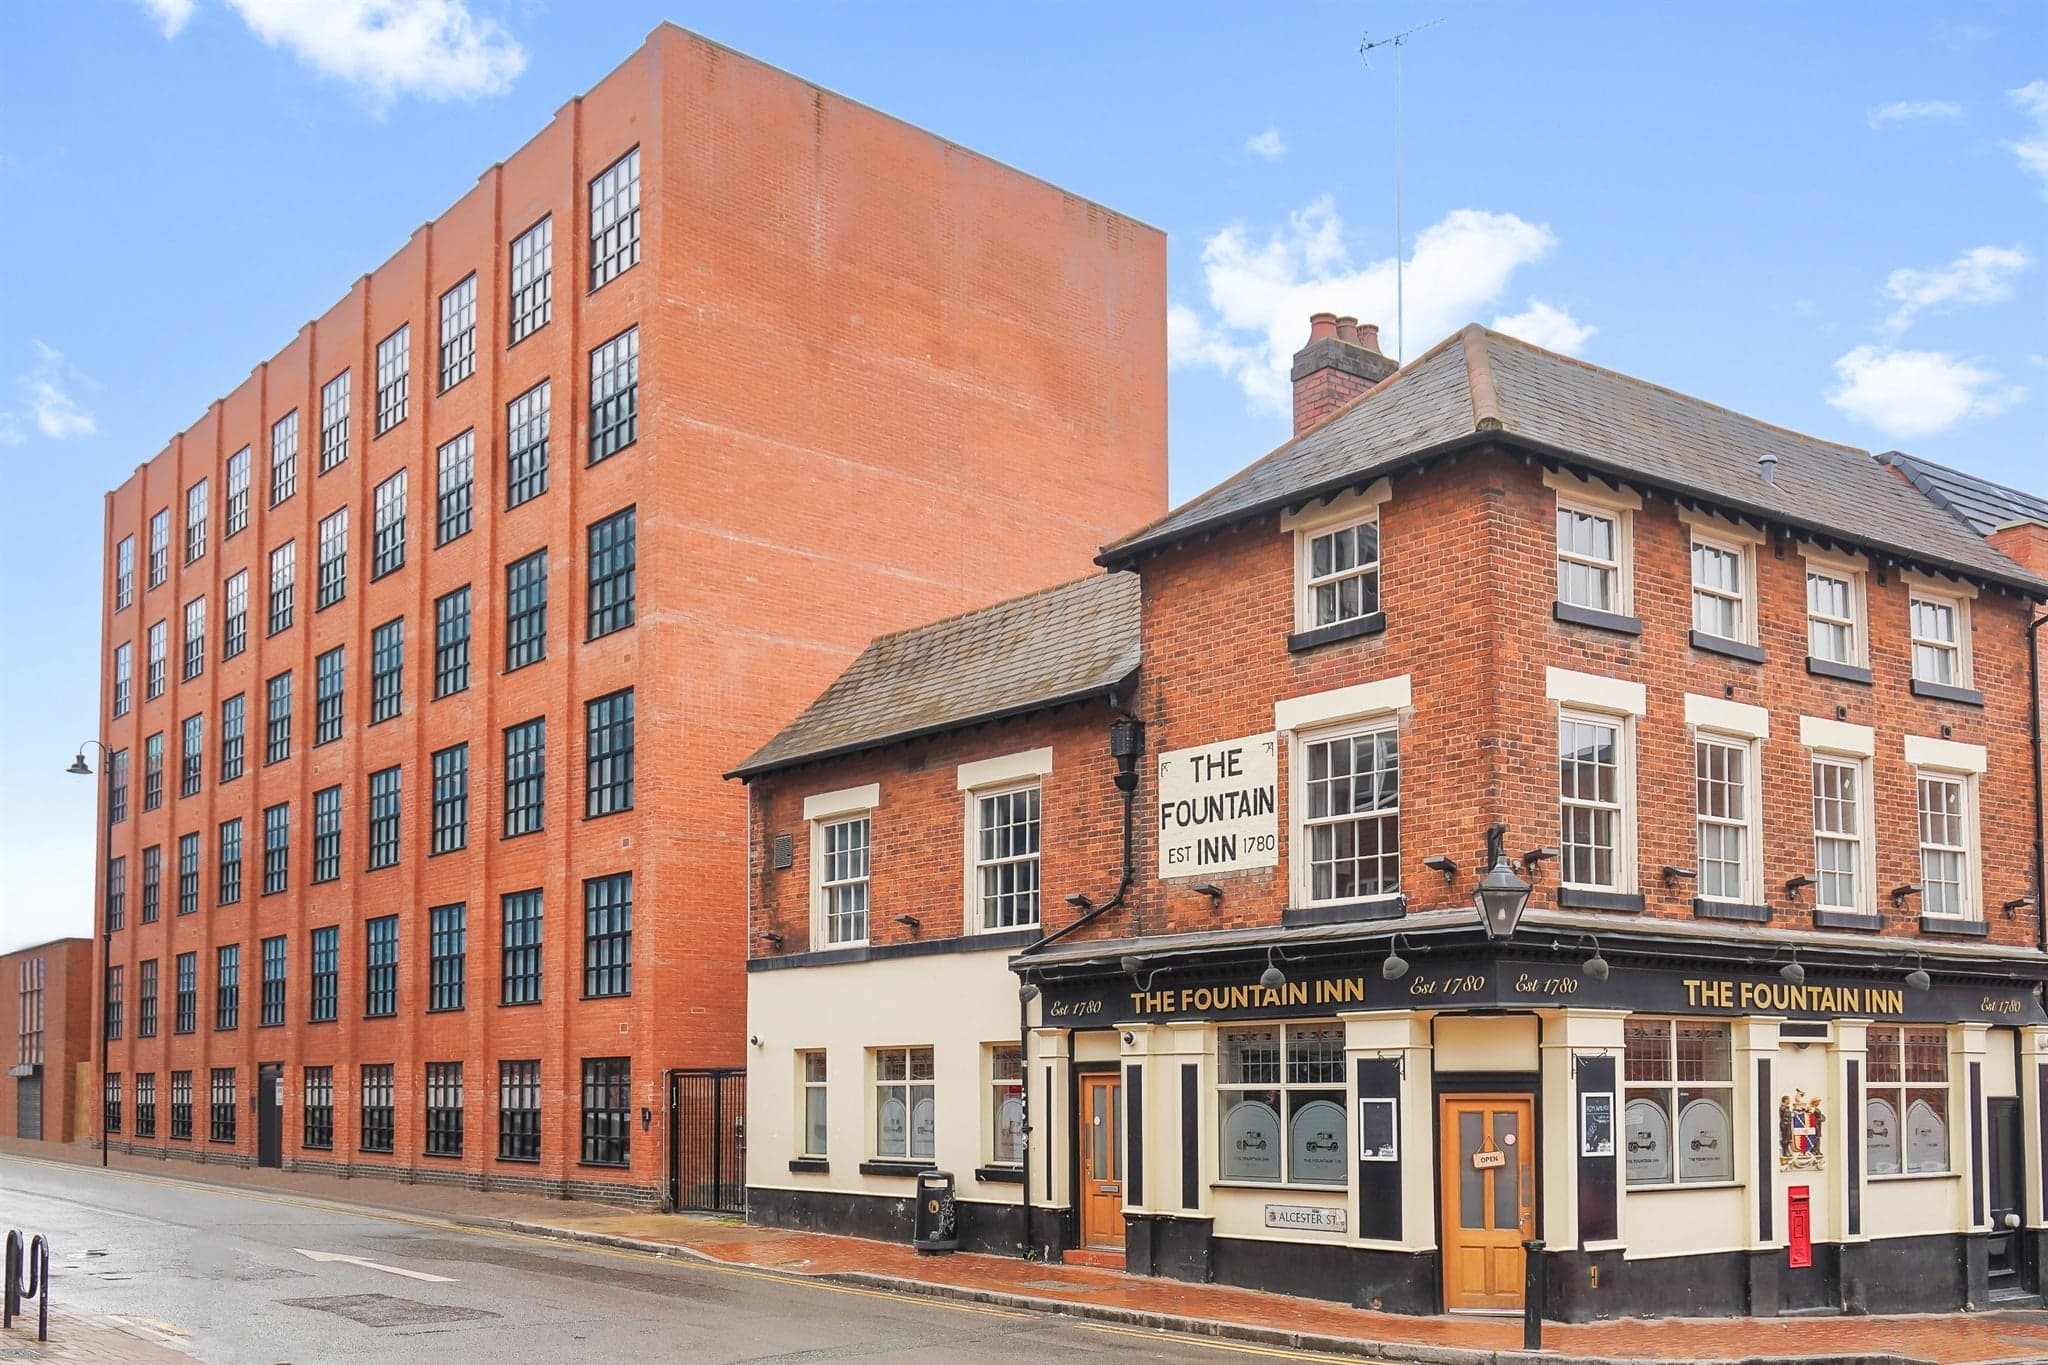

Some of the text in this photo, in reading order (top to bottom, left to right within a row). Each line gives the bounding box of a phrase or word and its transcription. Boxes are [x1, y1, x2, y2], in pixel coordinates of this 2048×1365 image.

[1190, 748, 1243, 783] THE
[1161, 785, 1274, 830] FOUNTAIN
[1168, 834, 1275, 865] EST INN 1780
[1131, 978, 1364, 1014] THE FOUNTAIN INN
[1410, 975, 1485, 995] Est 1780
[1515, 973, 1578, 995] Est 1780
[1683, 979, 1903, 1014] THE FOUNTAIN INN
[1050, 1000, 1102, 1017] Est 1780
[1980, 996, 2021, 1014] Est 1780
[1279, 1212, 1323, 1225] ALCESTER
